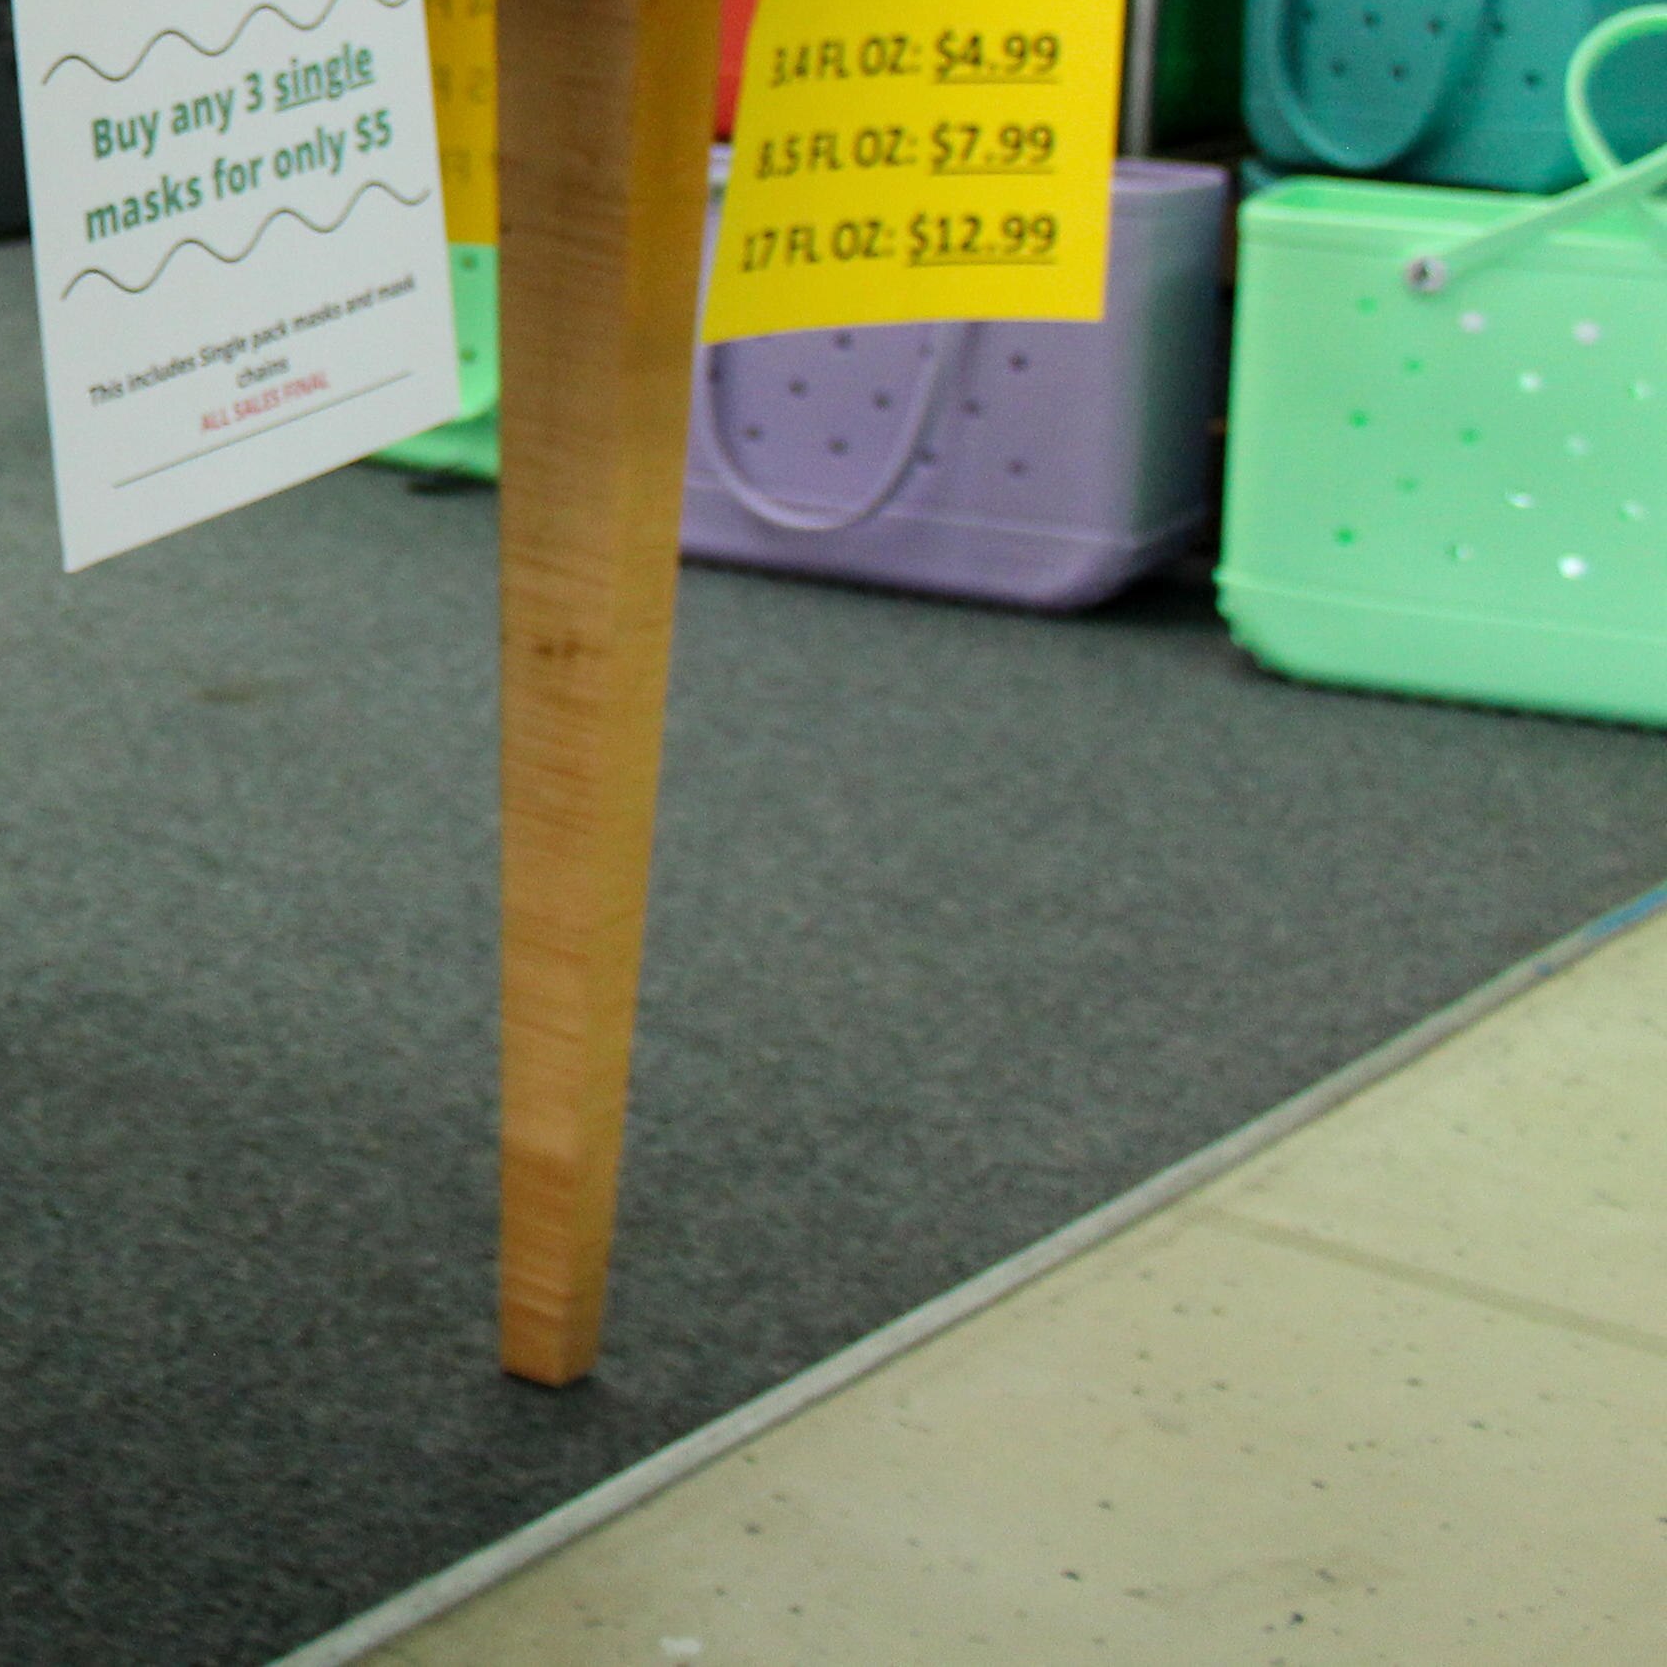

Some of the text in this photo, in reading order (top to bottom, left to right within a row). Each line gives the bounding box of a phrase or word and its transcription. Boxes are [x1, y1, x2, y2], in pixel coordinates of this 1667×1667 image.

[859, 34, 921, 77] OZ:
[932, 28, 1062, 84] $4.99
[91, 42, 375, 161] Buy any 3 single
[85, 108, 393, 241] masks for only $5
[854, 125, 918, 168] OZ:
[931, 122, 1054, 174] $7.99
[831, 219, 895, 262] OZ:
[906, 210, 1057, 267] $12.99
